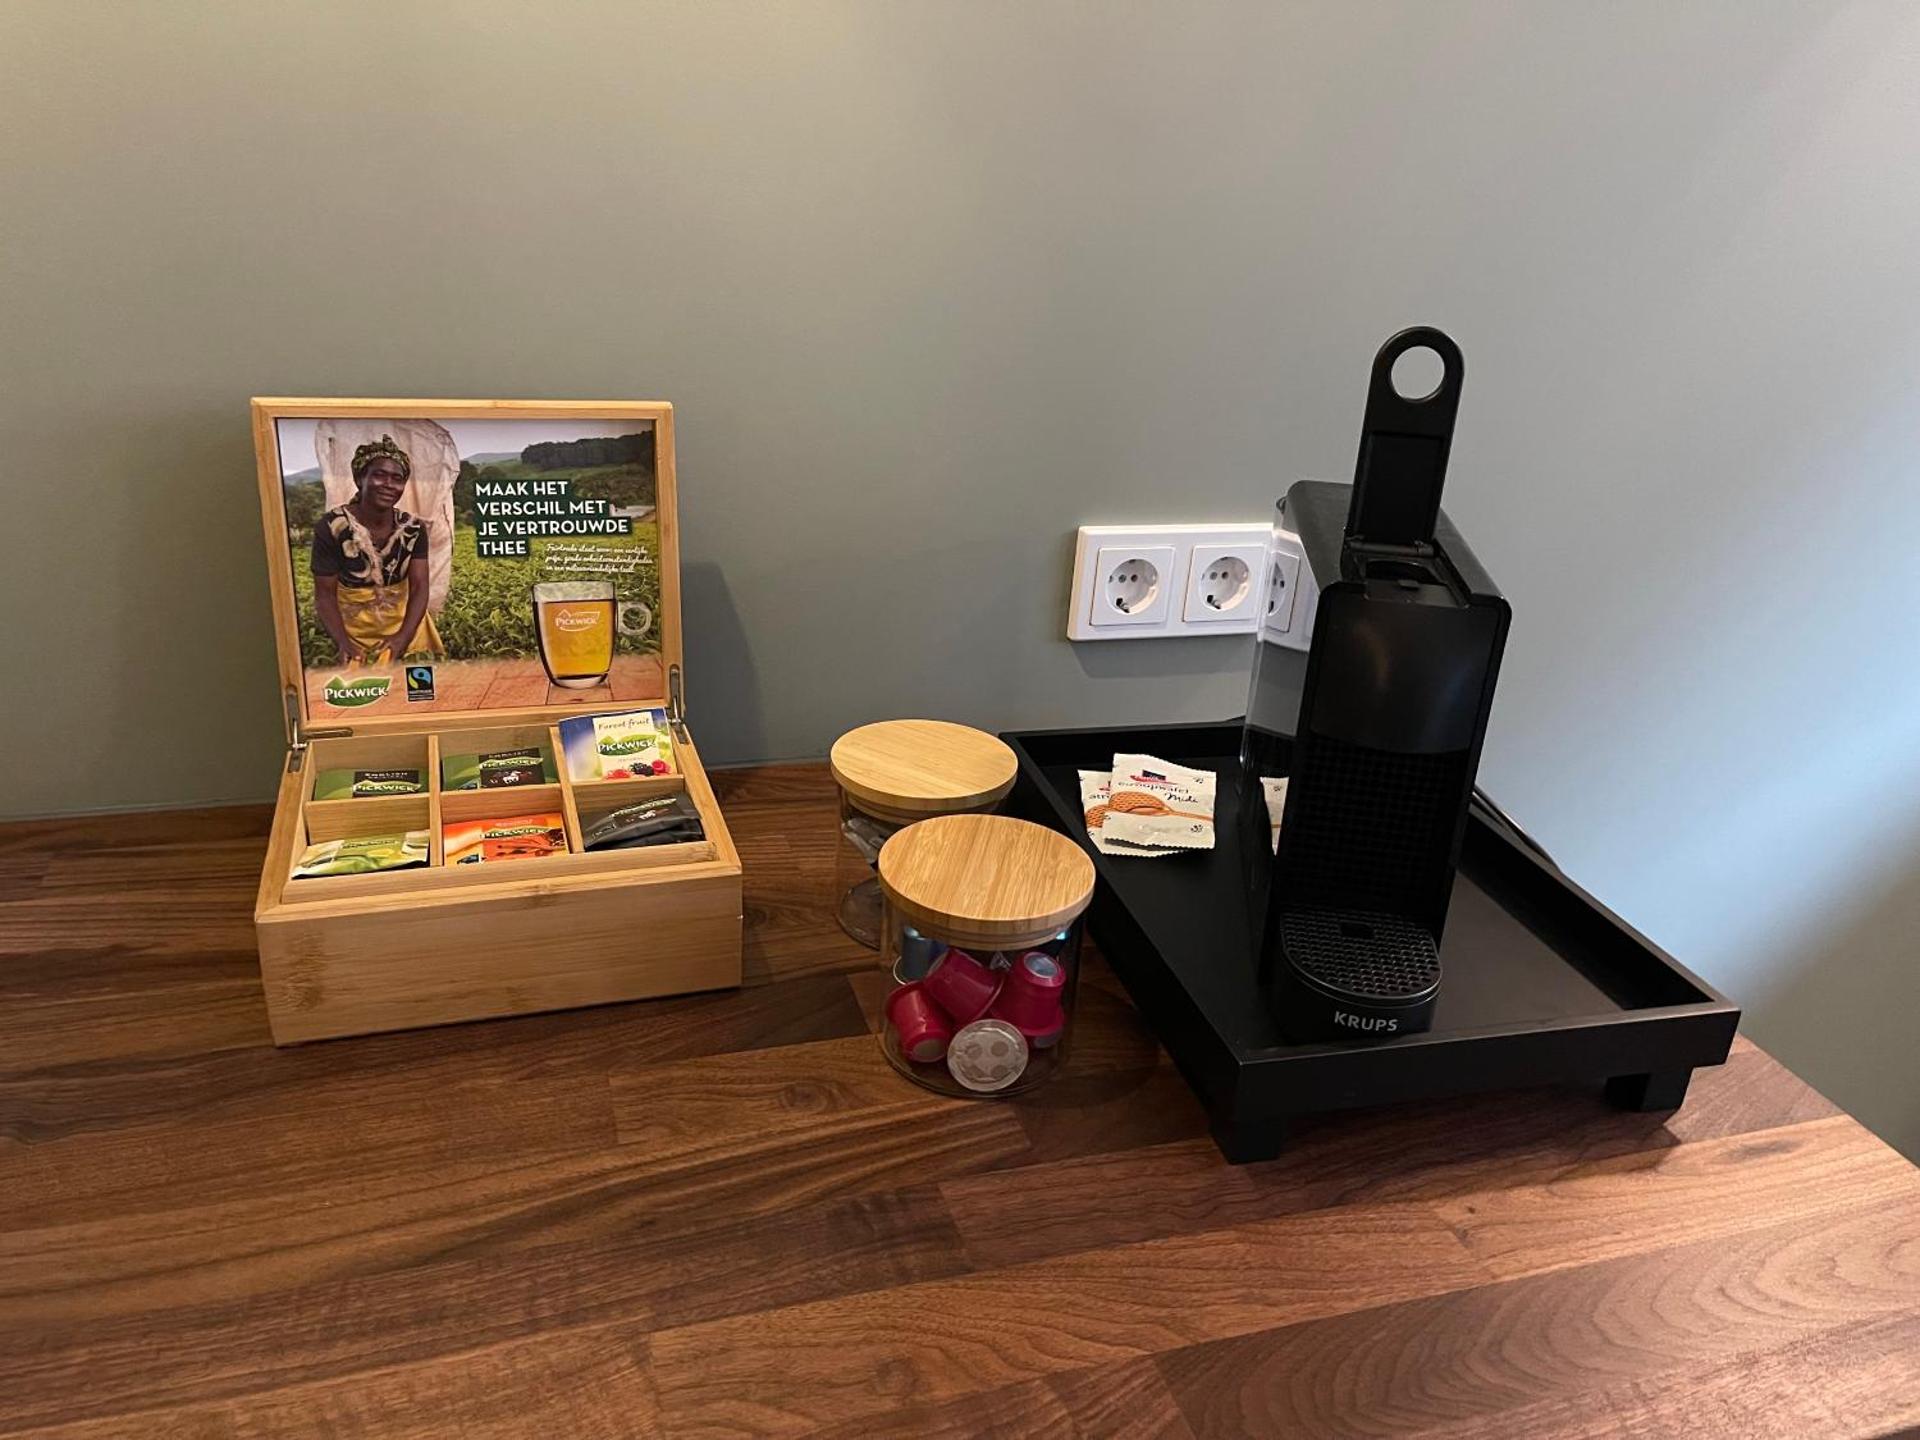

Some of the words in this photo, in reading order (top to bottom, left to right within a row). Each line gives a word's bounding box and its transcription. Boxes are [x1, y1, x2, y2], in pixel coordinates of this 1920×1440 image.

[475, 481, 529, 496] MAAK
[533, 481, 568, 495] HET
[477, 501, 565, 516] VERSCHIL
[569, 500, 606, 515] MET
[479, 522, 499, 536] JE
[503, 519, 629, 535] VERTROUWDE
[479, 540, 527, 556] THEE
[324, 686, 388, 700] PICKWICK
[598, 720, 626, 730] Forest
[628, 718, 650, 729] fruit
[597, 739, 656, 753] PICKWICK
[352, 784, 416, 793] PICKWICK
[1334, 1010, 1398, 1032] KRUPS
